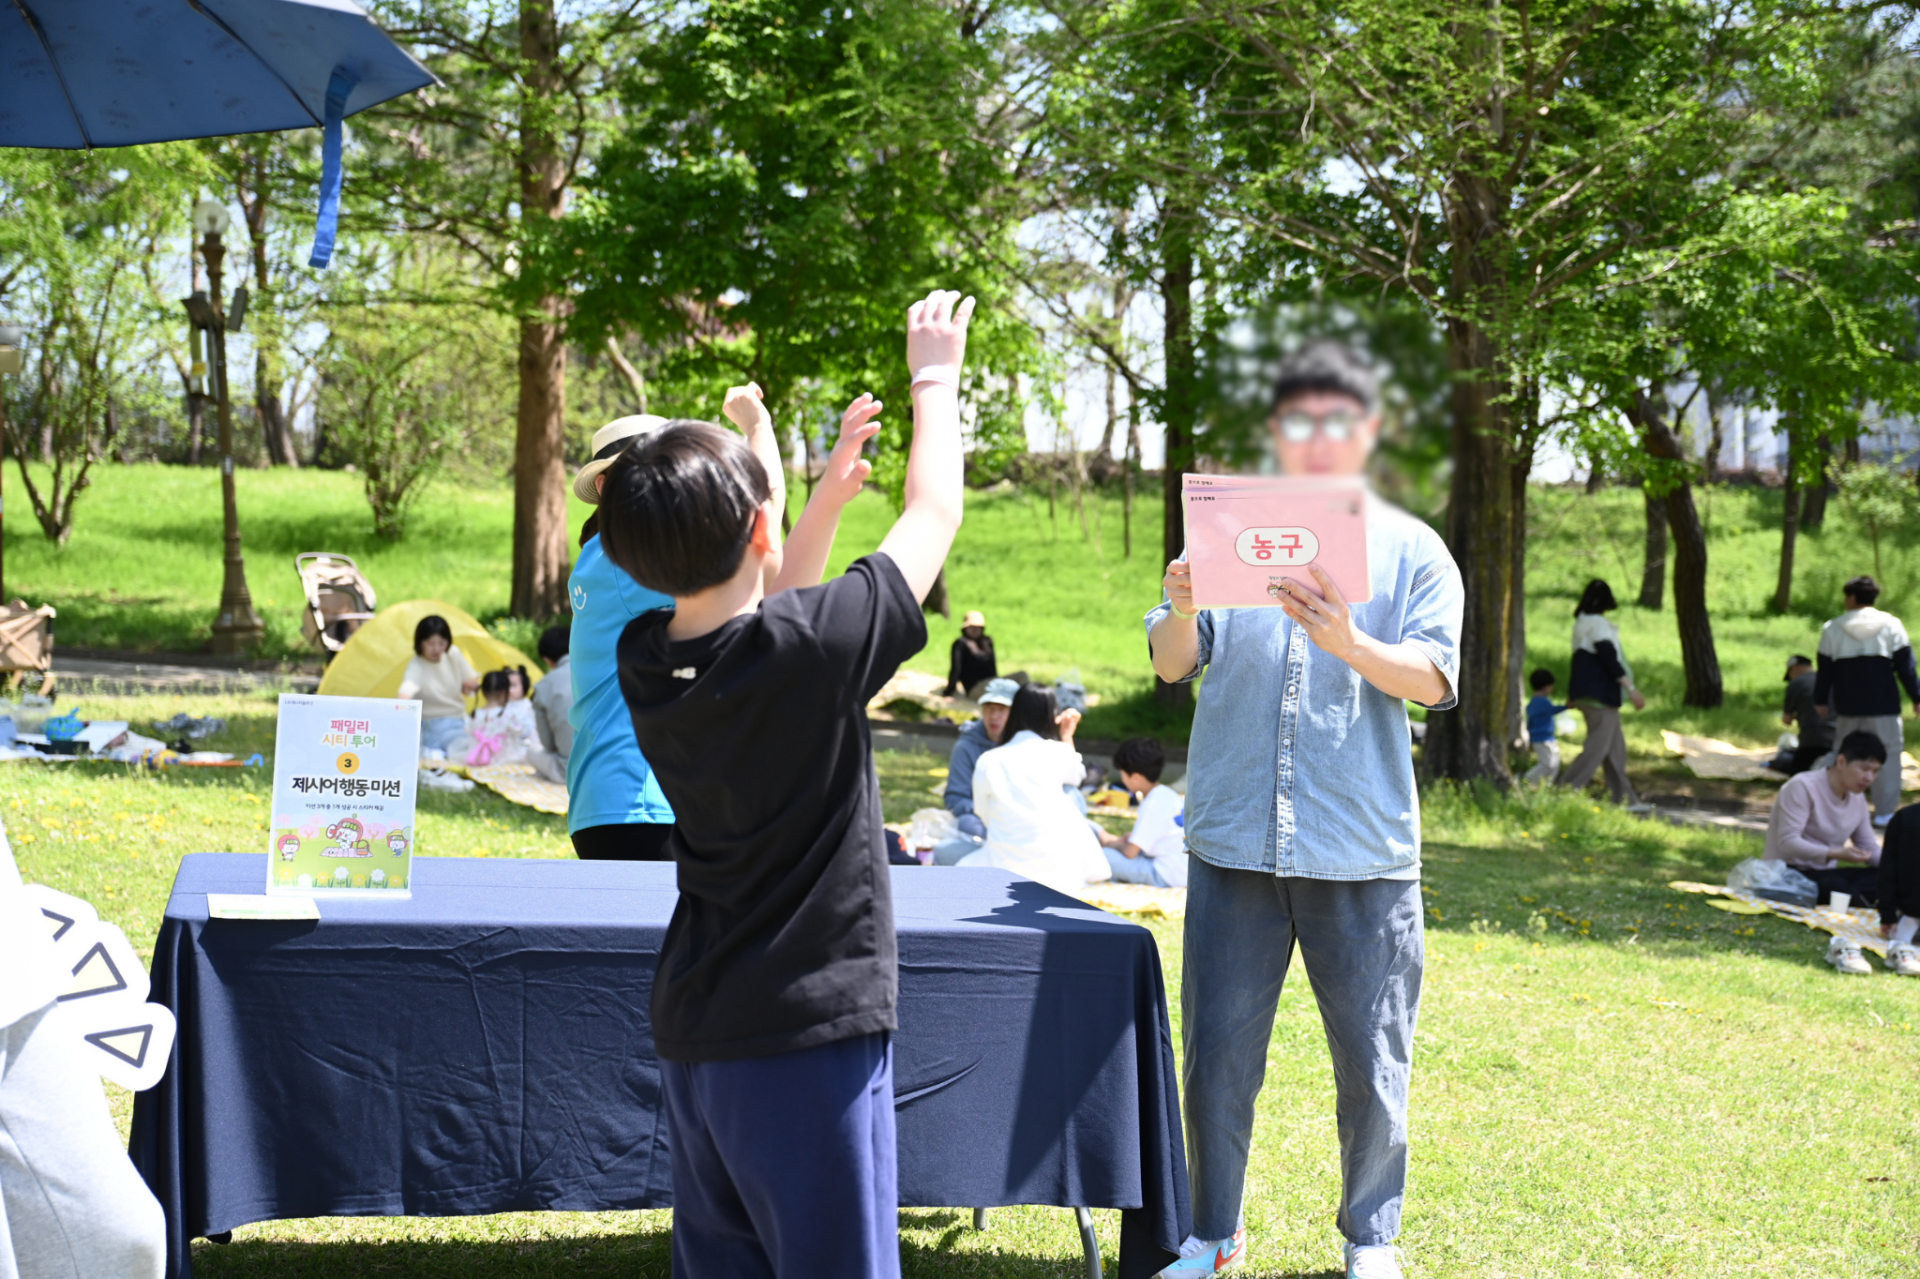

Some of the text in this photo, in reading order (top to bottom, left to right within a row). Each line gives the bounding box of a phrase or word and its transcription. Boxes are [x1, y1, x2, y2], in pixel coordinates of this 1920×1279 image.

[1250, 533, 1304, 560] 농구
[330, 719, 369, 734] 패밀리
[322, 734, 376, 748] 시티 투어
[344, 758, 352, 768] 3
